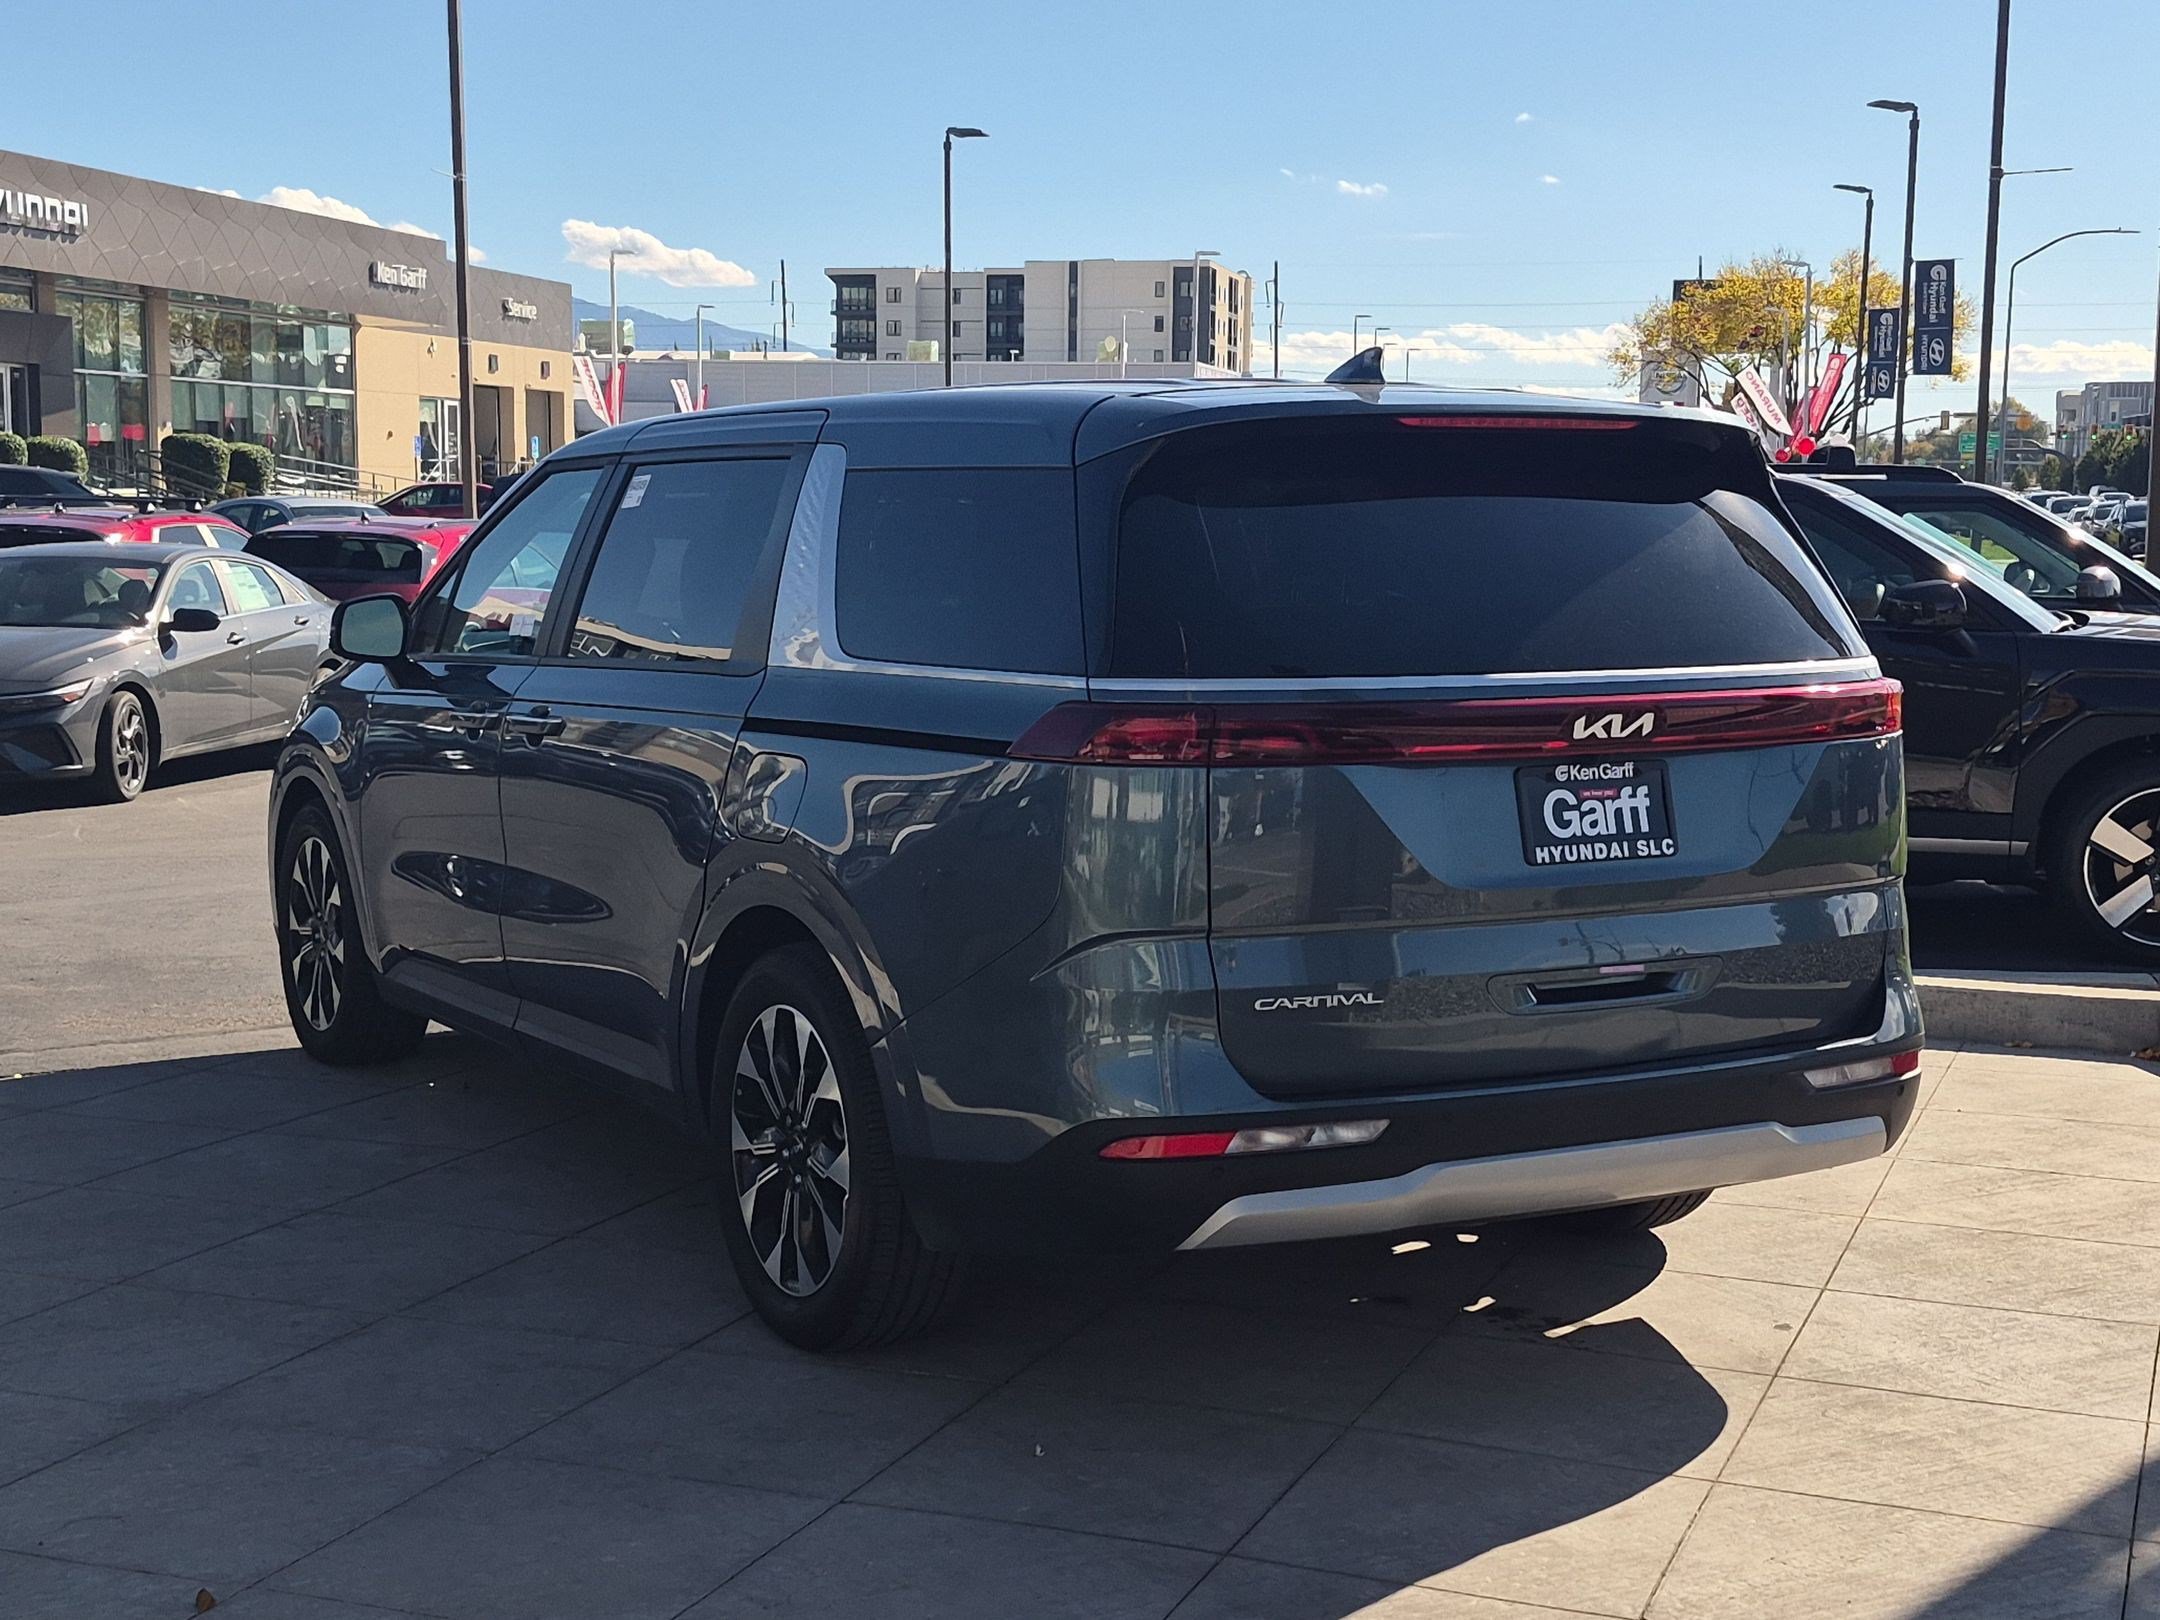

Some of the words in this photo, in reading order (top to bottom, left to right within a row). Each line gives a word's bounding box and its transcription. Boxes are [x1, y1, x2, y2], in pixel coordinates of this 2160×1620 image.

[0, 188, 89, 235] UNDAI
[377, 261, 398, 286] Ken
[399, 264, 428, 290] Garff
[503, 298, 538, 320] Service
[1928, 281, 1939, 323] Hyundai
[1573, 712, 1655, 740] KIA
[1569, 764, 1599, 781] Ken
[1599, 761, 1635, 780] Garff
[1543, 785, 1651, 839] Garff
[1535, 841, 1630, 864] HYUNDAI
[1636, 838, 1675, 857] SLC
[1254, 992, 1385, 1011] CARNIVAL
